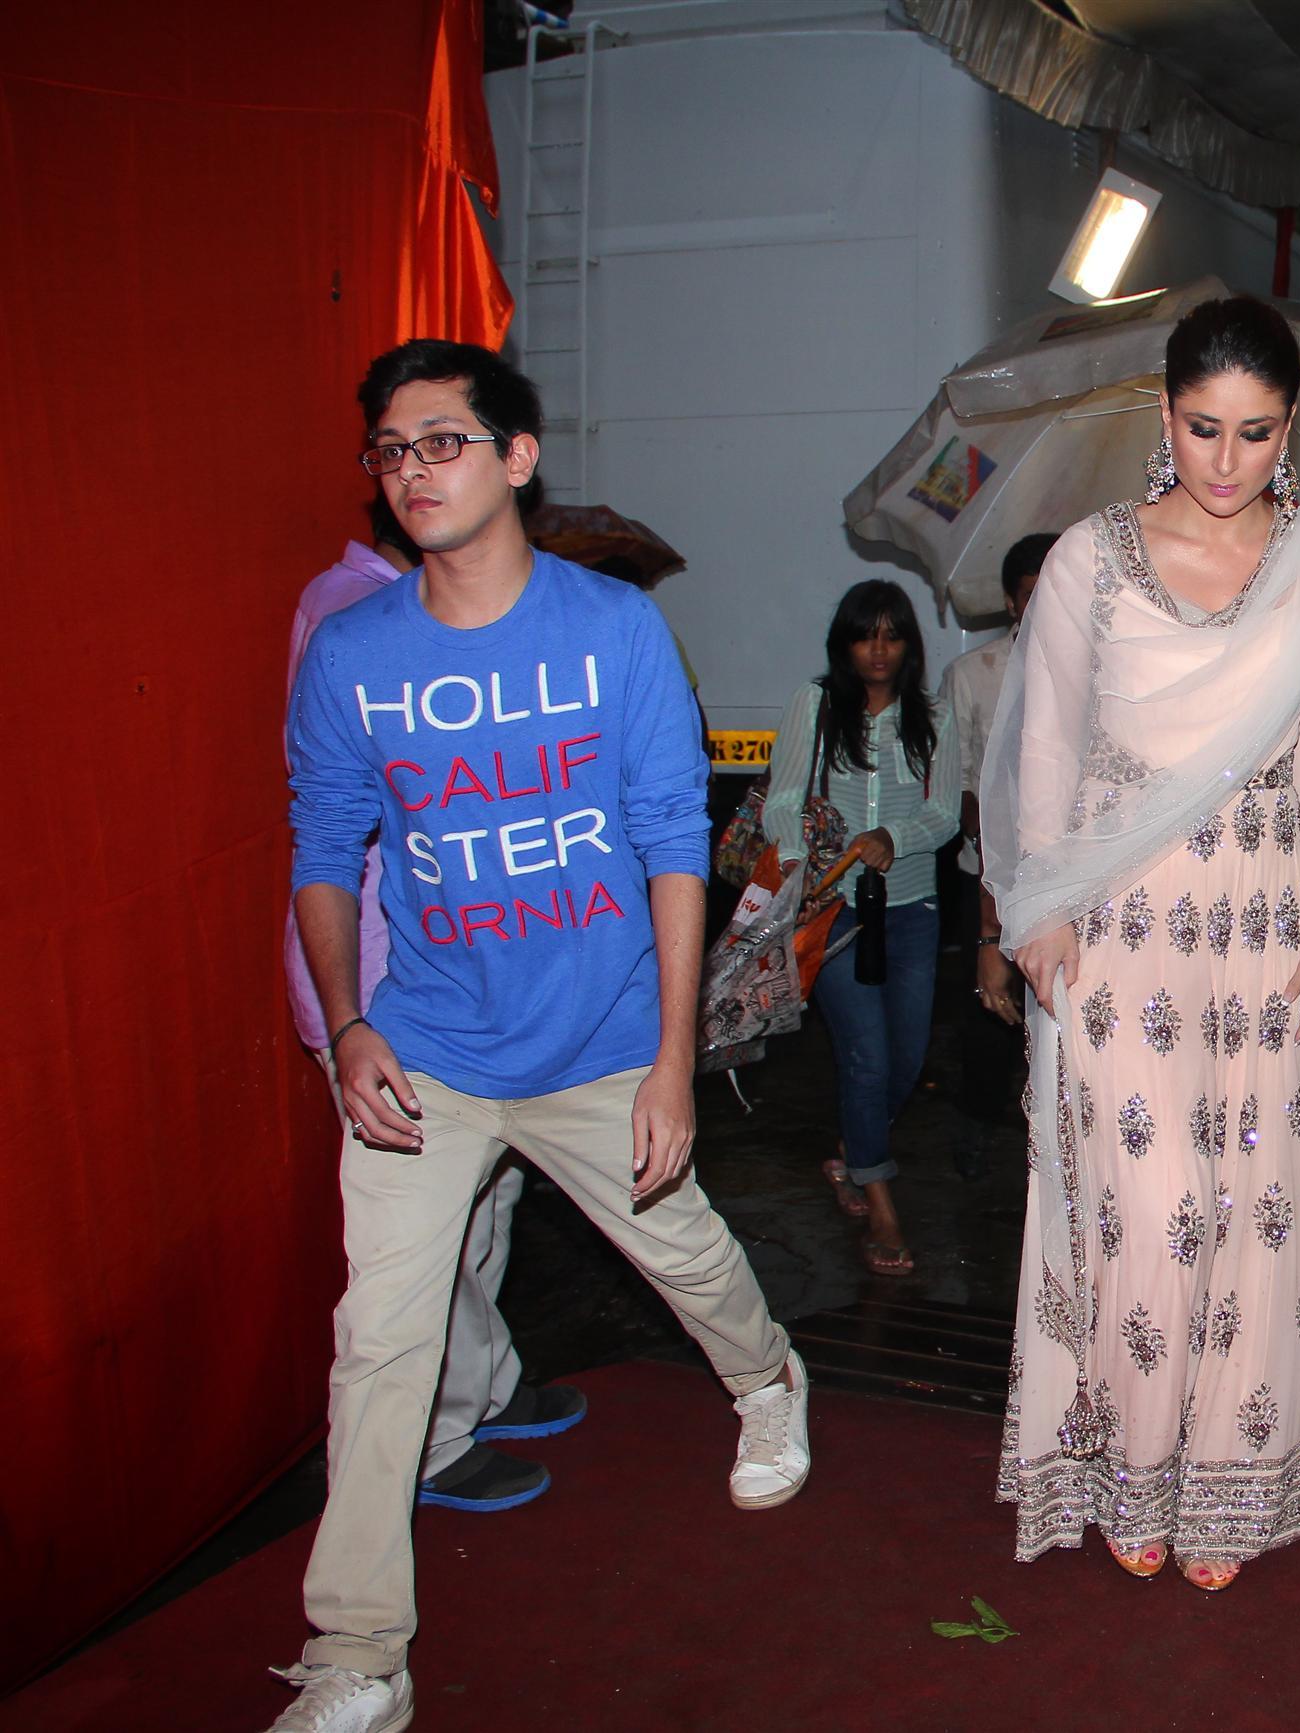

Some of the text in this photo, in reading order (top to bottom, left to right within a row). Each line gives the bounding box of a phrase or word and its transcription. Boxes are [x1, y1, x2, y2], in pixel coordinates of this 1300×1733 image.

[355, 654, 600, 736] HOLLI
[385, 732, 601, 812] CALIF
[407, 807, 612, 885] STER
[421, 881, 625, 947] ORNIA
